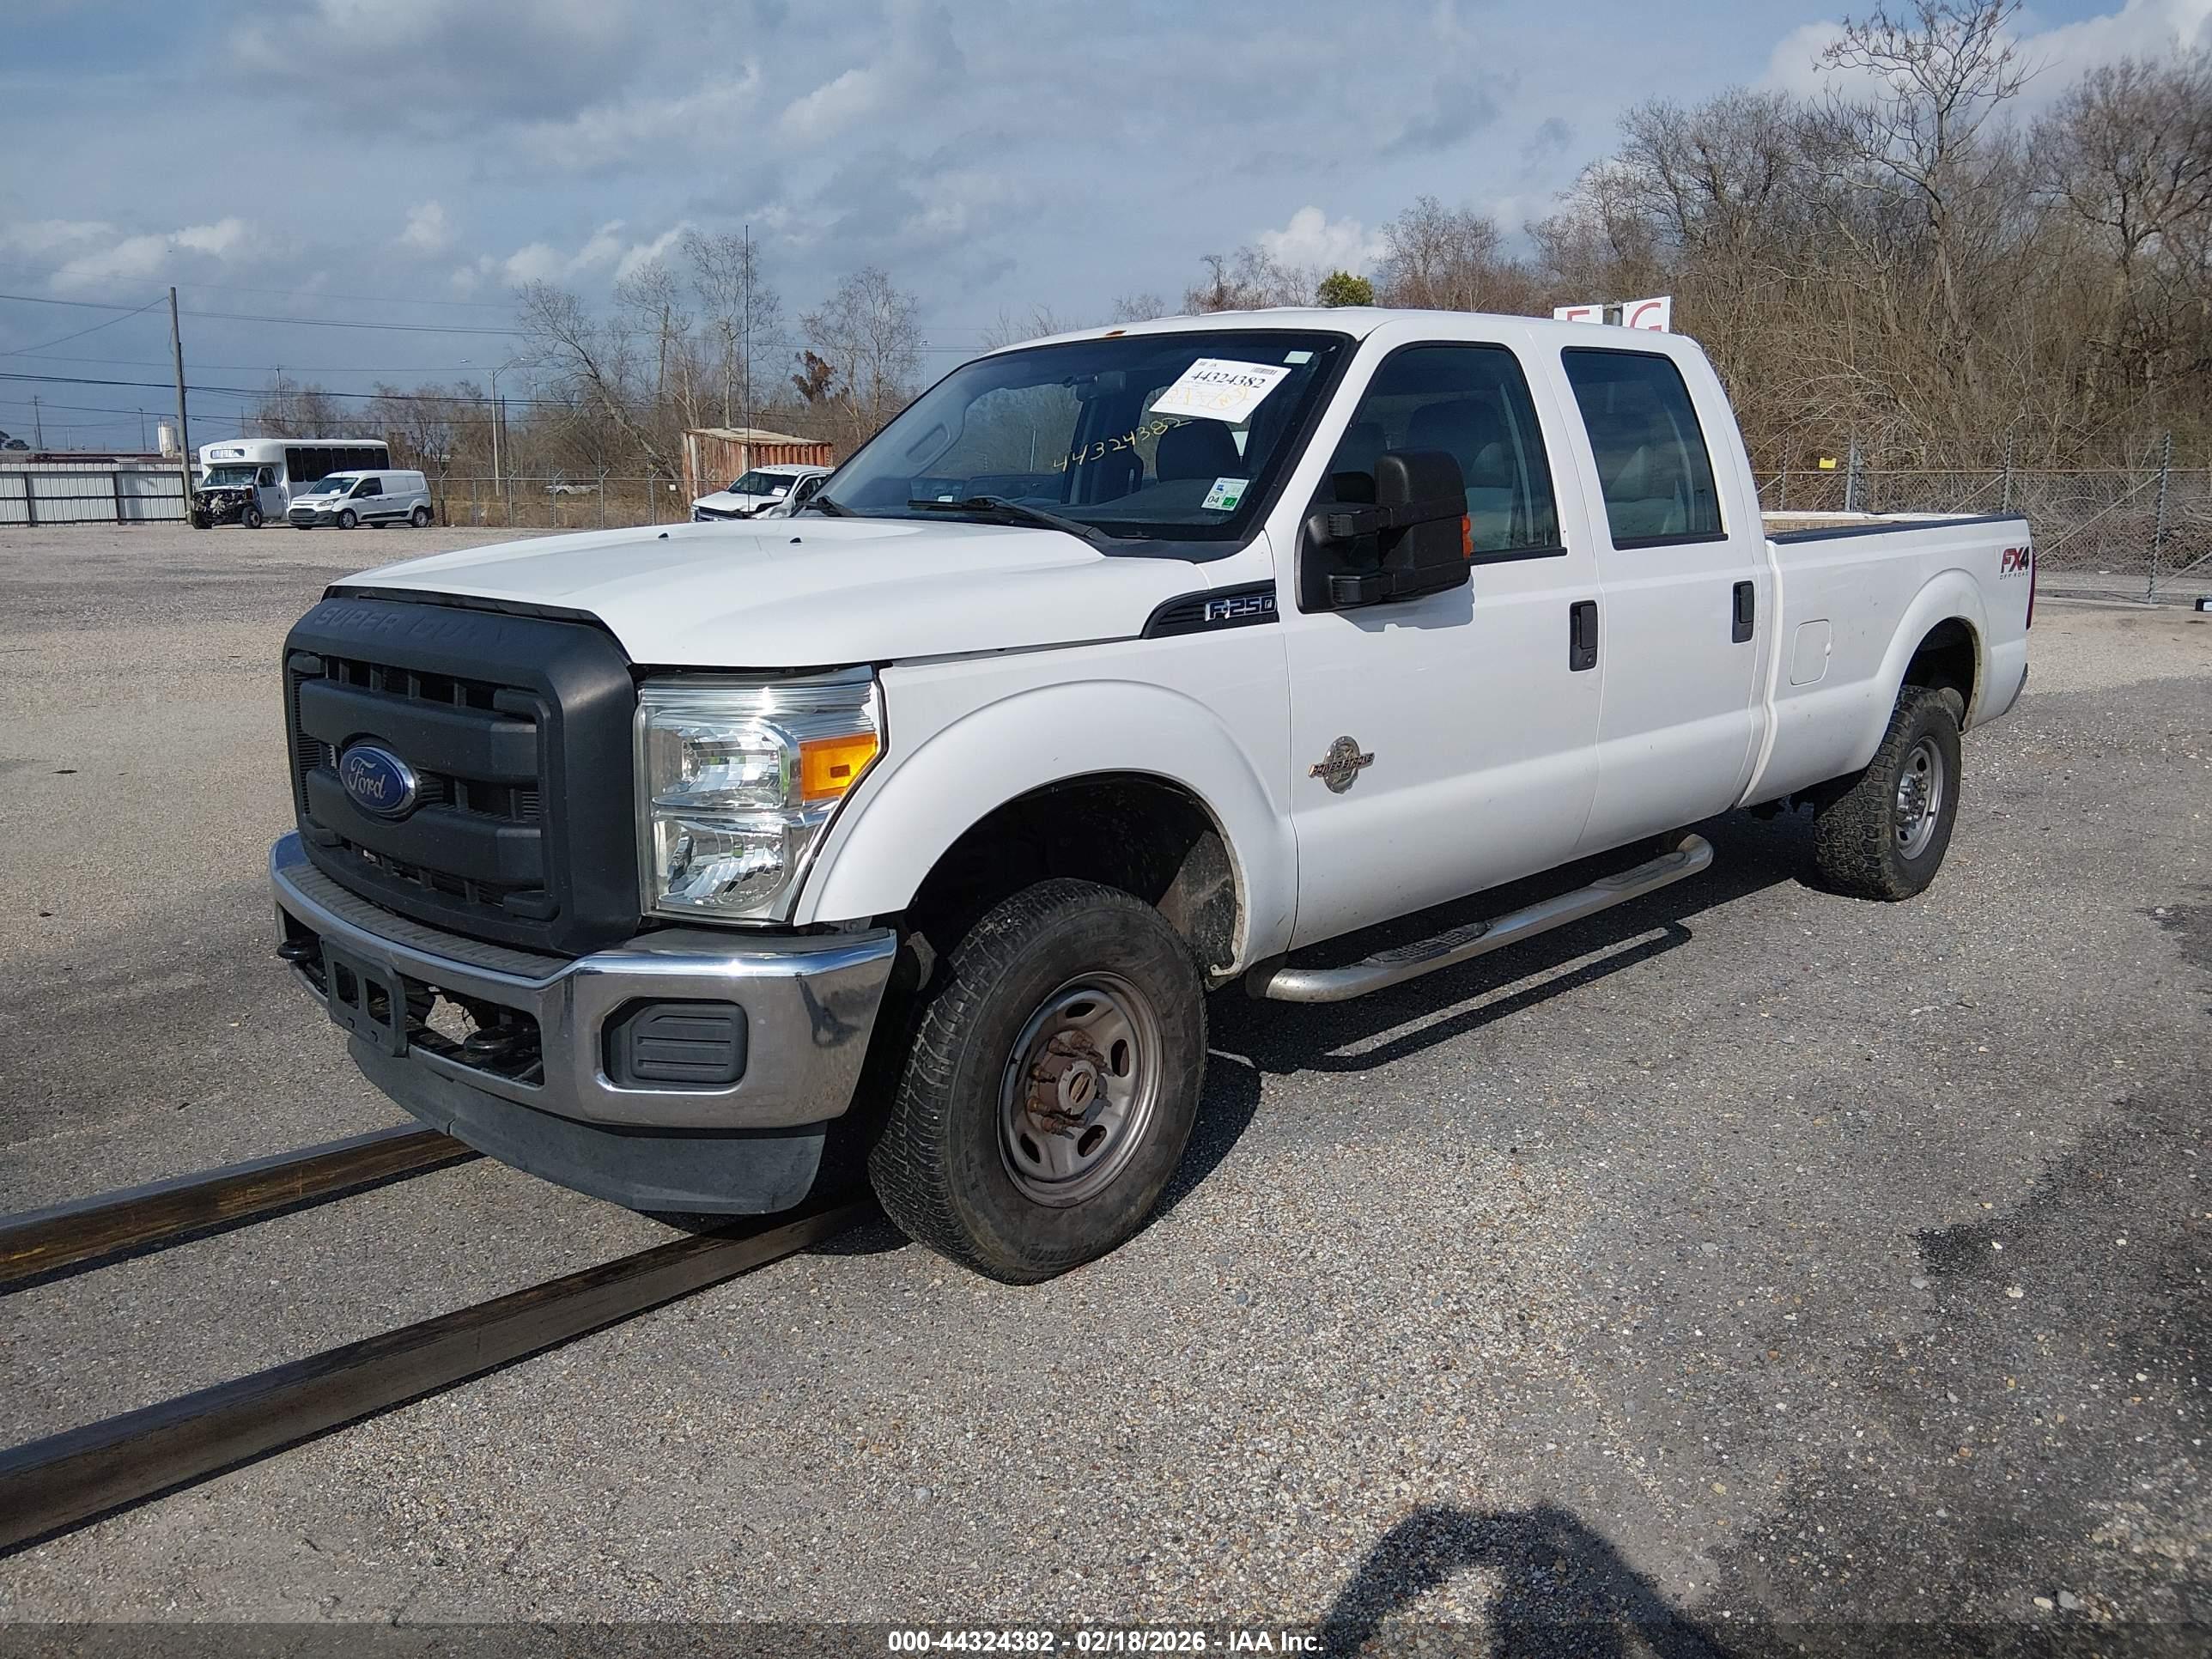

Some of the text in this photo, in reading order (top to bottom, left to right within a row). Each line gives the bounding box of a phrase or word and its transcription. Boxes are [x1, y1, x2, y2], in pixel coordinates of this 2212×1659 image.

[1190, 369, 1267, 389] 44324382
[1052, 417, 1194, 471] 44324382
[1207, 495, 1220, 504] 04
[2000, 545, 2030, 574] FX4
[313, 606, 405, 634] SUPER
[1205, 595, 1278, 622] F-250
[348, 757, 387, 800] Ford
